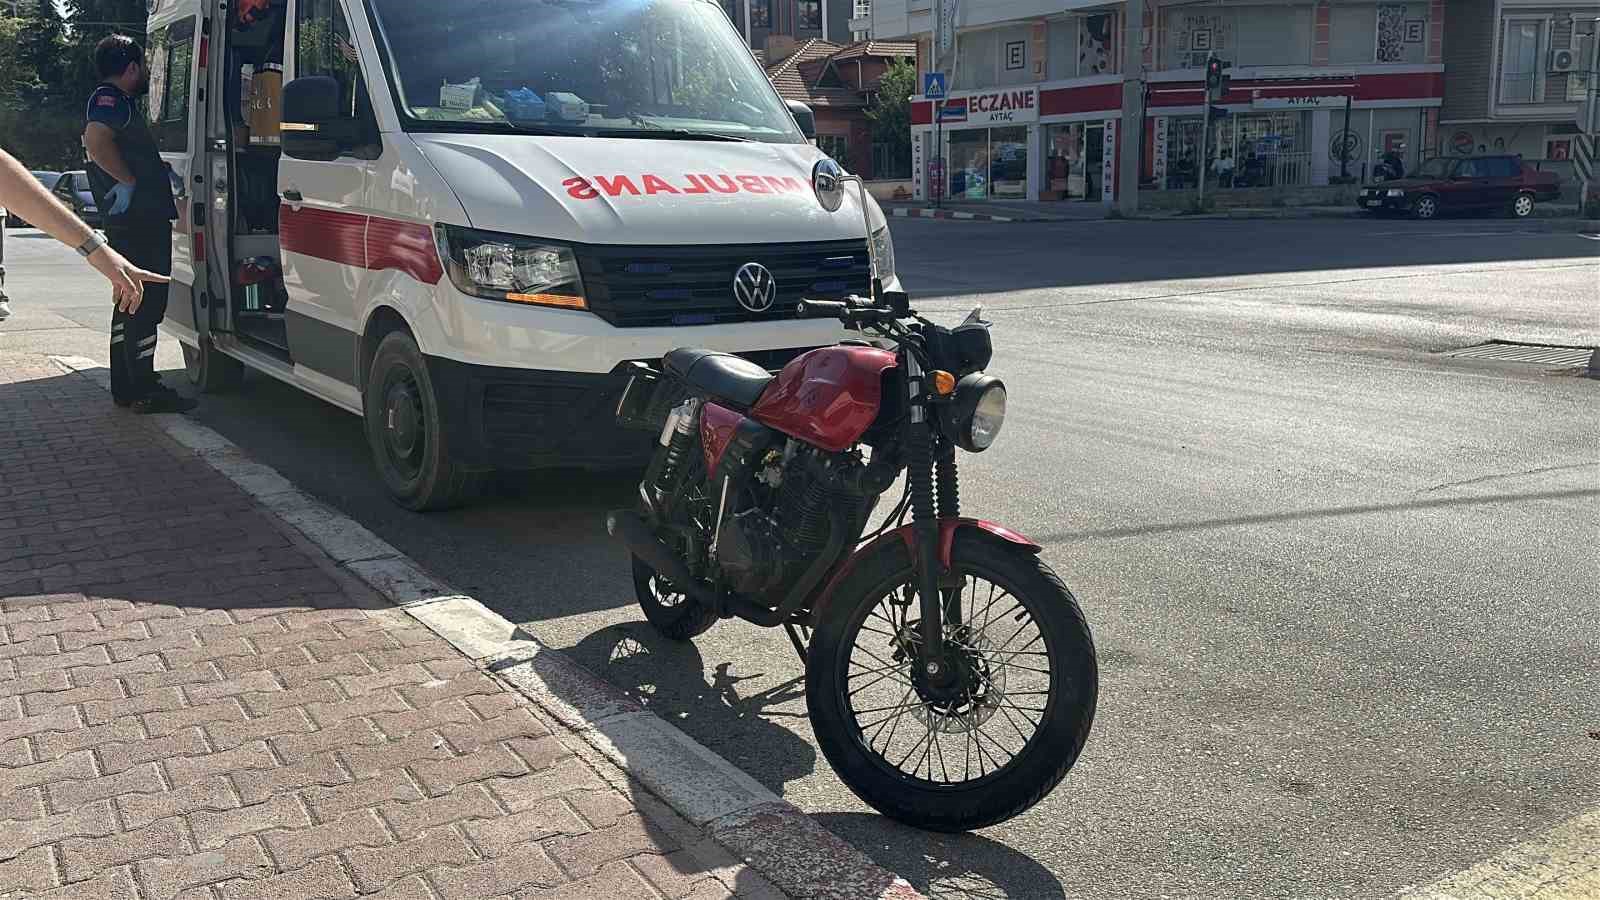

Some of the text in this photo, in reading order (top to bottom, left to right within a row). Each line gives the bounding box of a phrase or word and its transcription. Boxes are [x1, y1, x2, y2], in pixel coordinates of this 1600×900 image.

[969, 90, 1034, 113] ECZANE
[990, 112, 1014, 122] AYTAÇ
[1104, 121, 1113, 193] ECZANE
[1155, 119, 1166, 178] ECZAN
